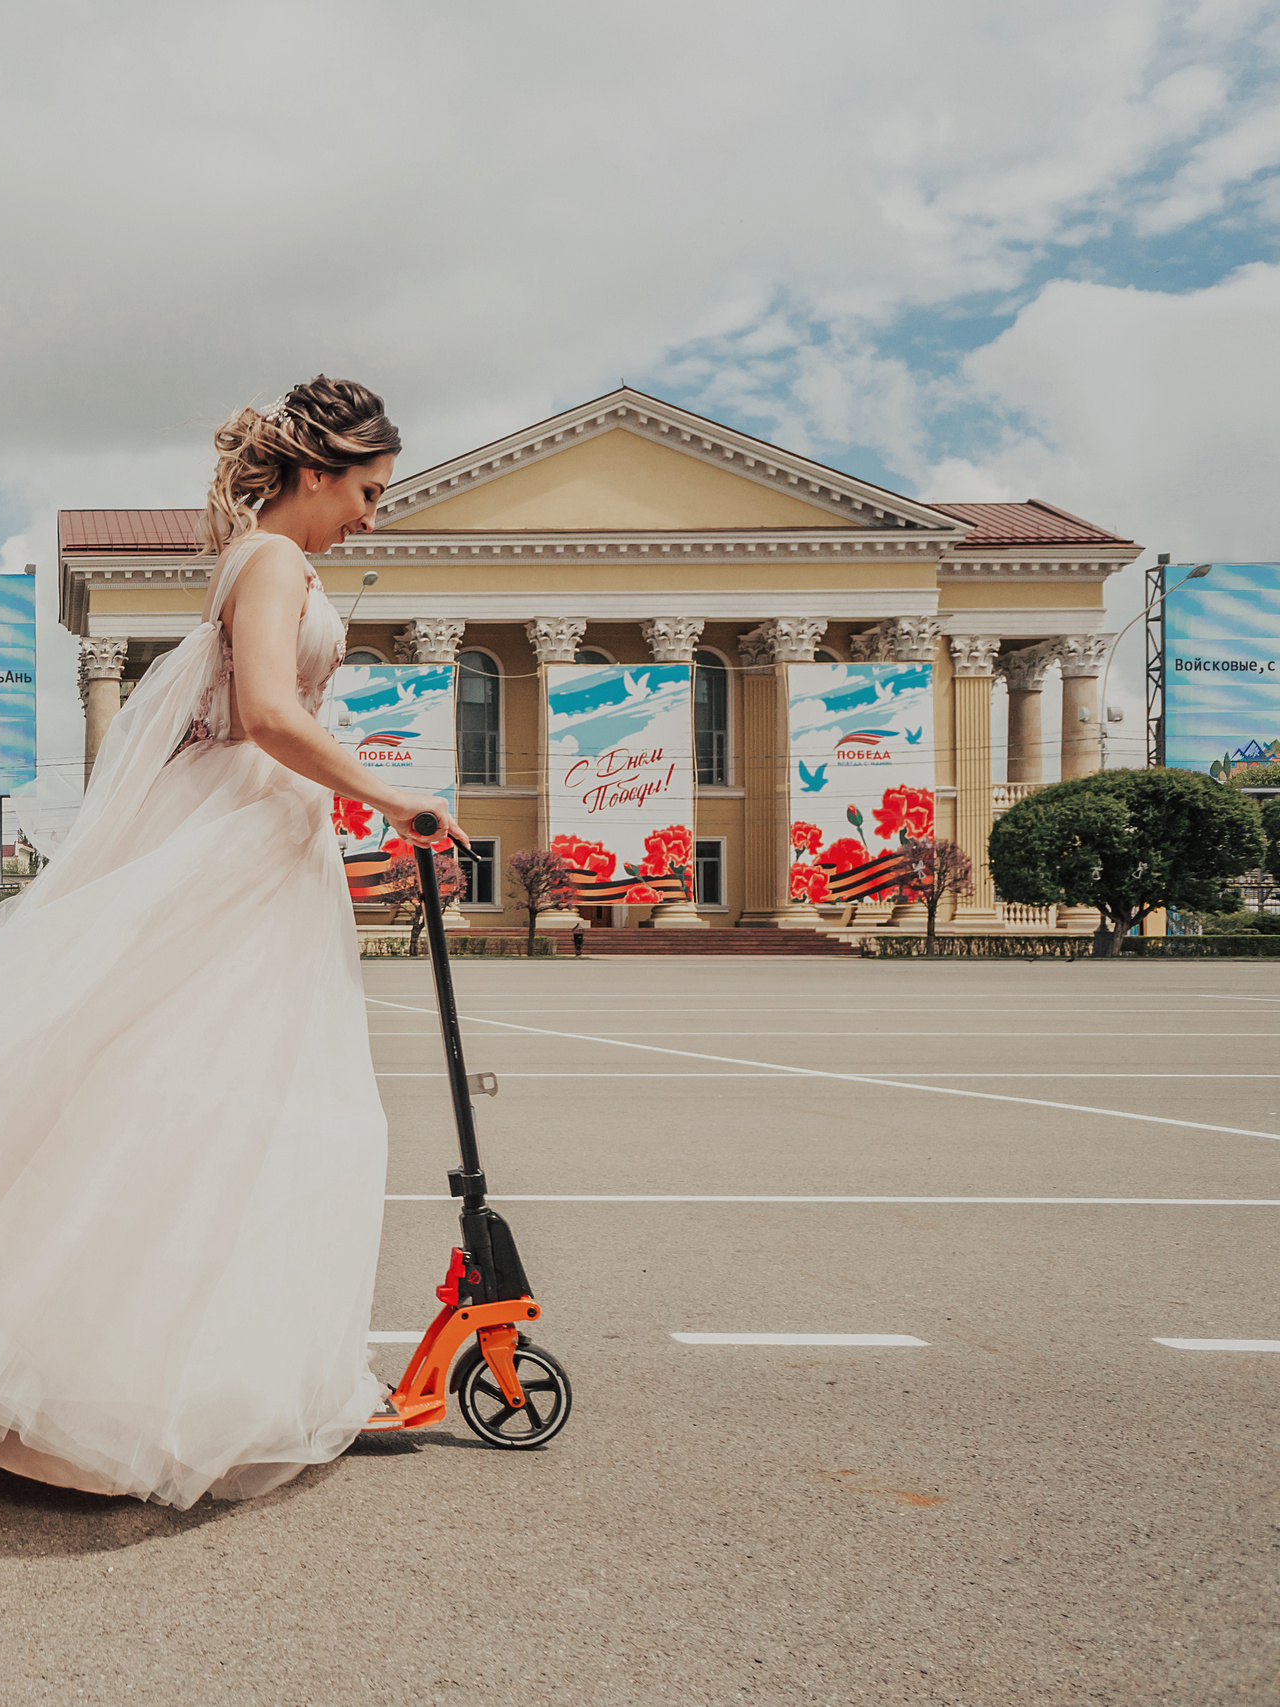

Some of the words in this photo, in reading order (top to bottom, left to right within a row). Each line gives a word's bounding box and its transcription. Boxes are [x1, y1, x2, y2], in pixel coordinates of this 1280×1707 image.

[359, 751, 412, 761] ПОБЕДА
[837, 750, 891, 760] ПОБЕДА
[564, 760, 589, 788] С
[596, 748, 663, 778] Днём
[582, 763, 675, 813] Победы!
